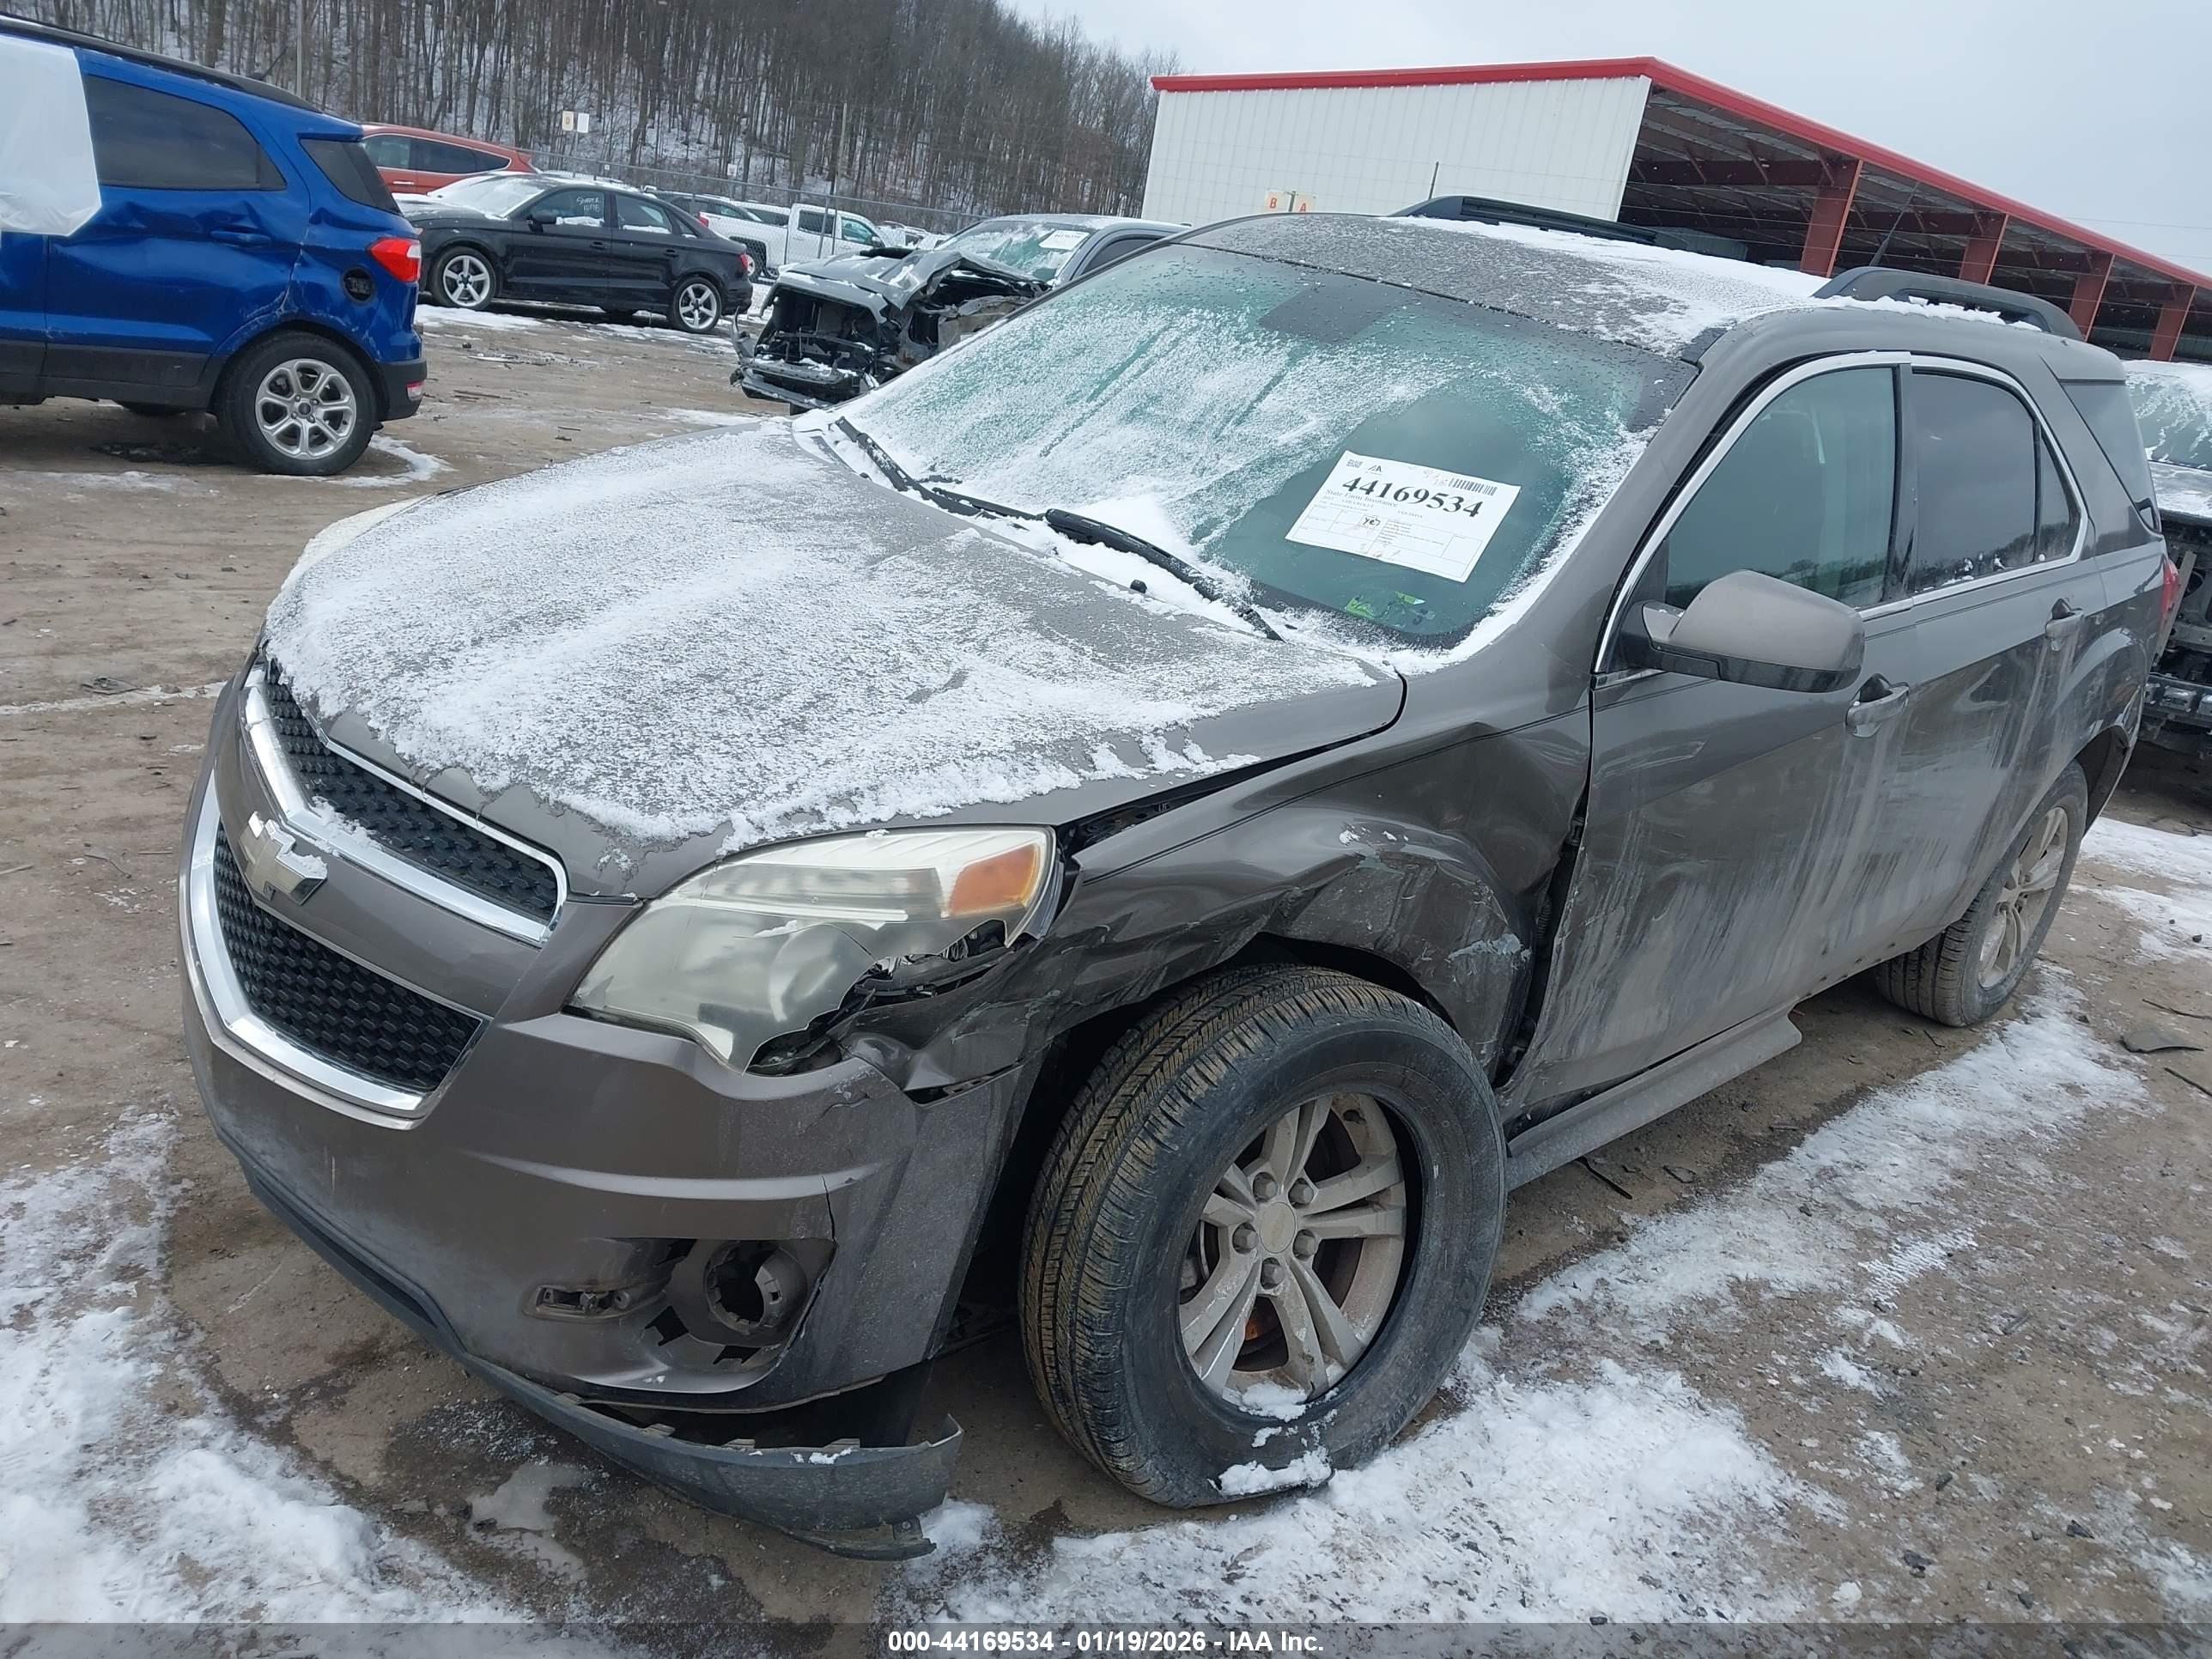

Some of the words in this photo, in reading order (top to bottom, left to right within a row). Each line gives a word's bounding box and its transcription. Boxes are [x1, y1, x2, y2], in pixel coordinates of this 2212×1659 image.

[1269, 198, 1277, 209] B
[1299, 203, 1306, 212] A
[1326, 489, 1344, 497] State
[1345, 492, 1364, 501] Farm
[1364, 495, 1399, 507] Insurance
[1342, 477, 1483, 518] 44169534
